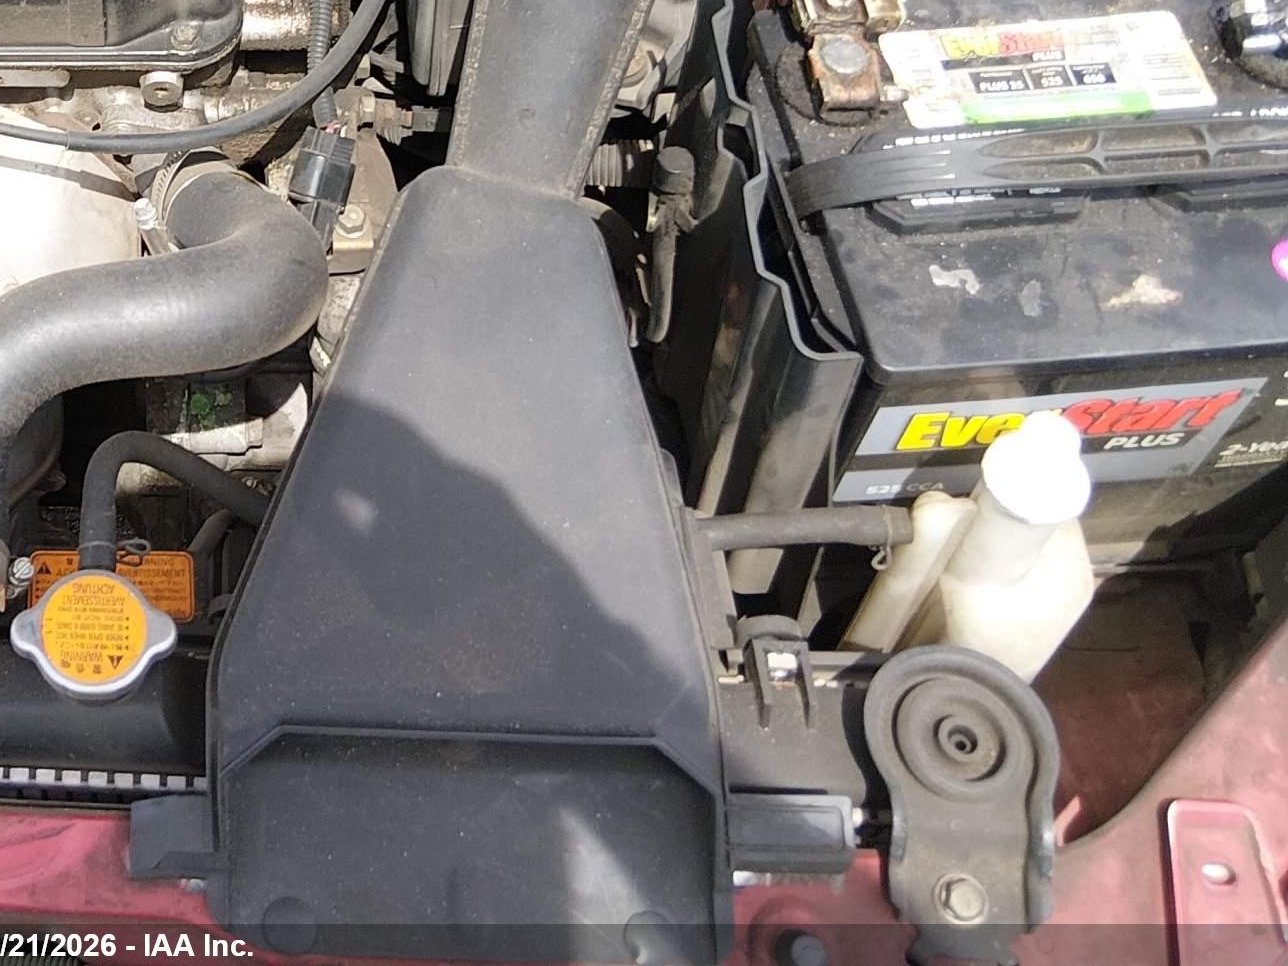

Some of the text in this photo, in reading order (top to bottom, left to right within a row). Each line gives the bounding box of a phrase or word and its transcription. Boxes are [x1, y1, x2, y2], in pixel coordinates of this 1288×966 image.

[896, 388, 1243, 450] EveStart
[1103, 432, 1186, 451] PLUS
[60, 650, 103, 663] WARNING
